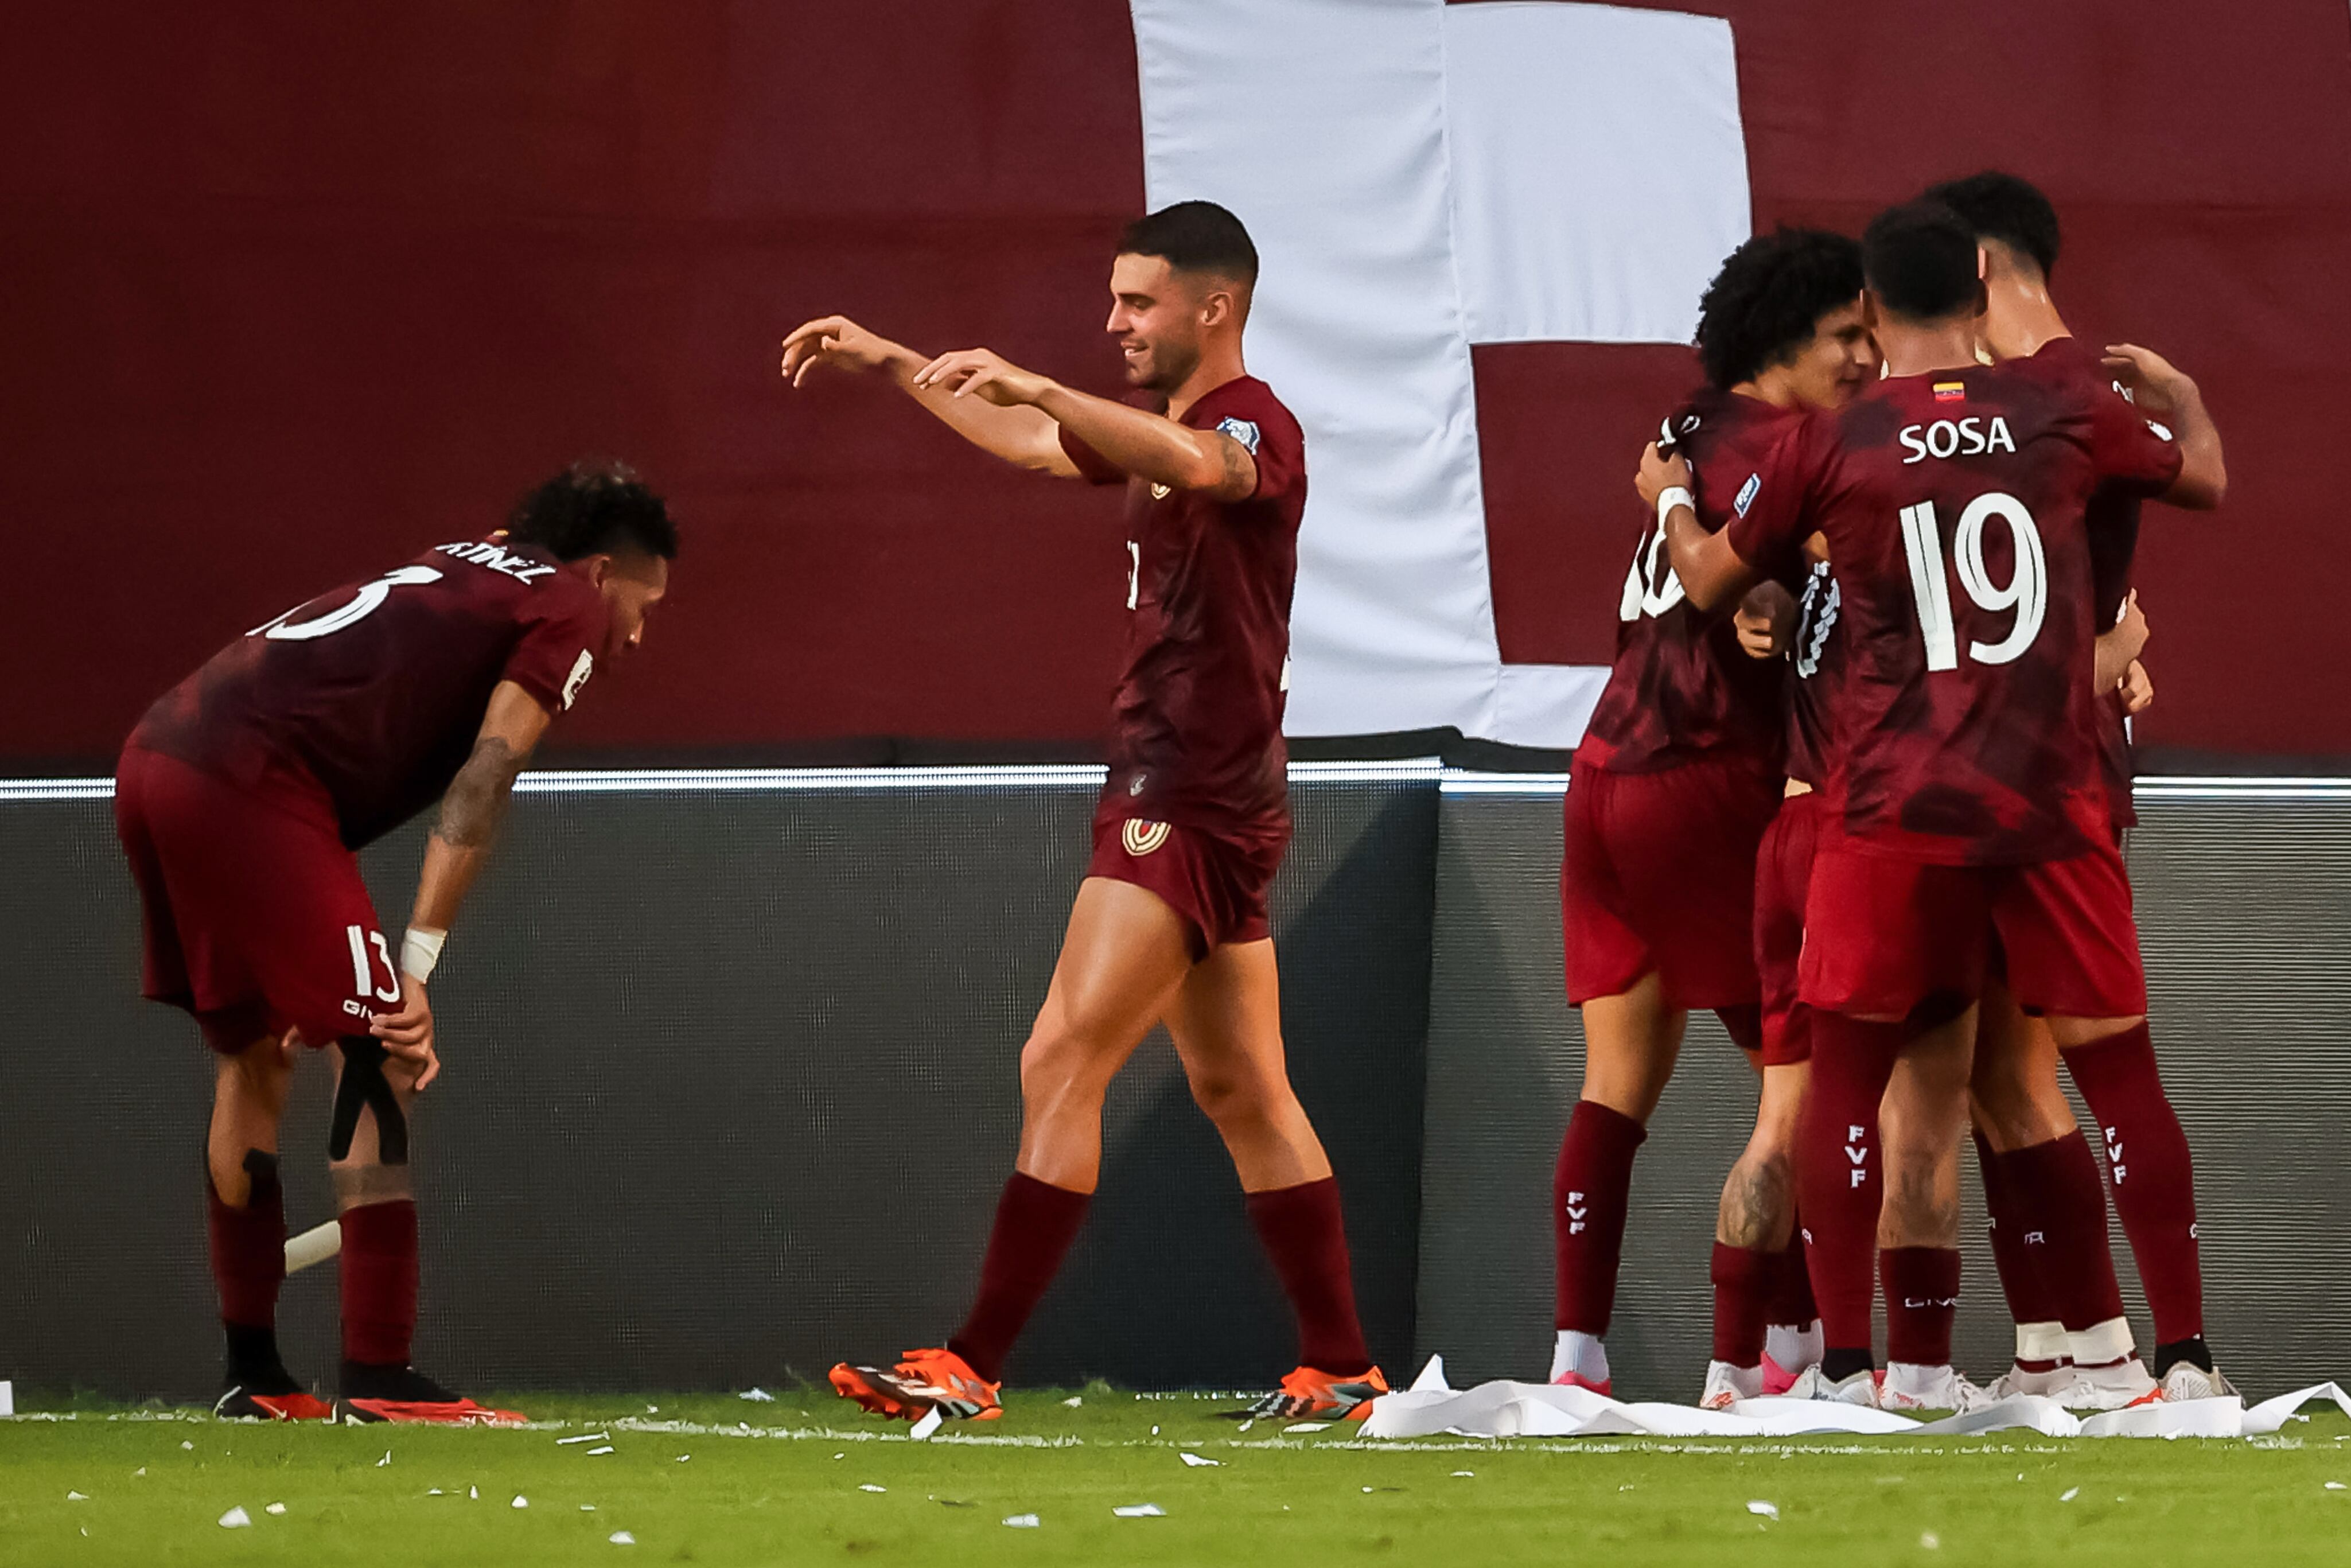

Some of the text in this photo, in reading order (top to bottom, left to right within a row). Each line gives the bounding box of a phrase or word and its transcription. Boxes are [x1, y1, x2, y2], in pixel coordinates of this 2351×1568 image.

[1899, 417, 2017, 464] SOSA
[1899, 492, 2048, 672] 19
[346, 924, 400, 1003] 13
[1844, 1125, 1868, 1188] FVF
[2105, 1126, 2127, 1185] FVF
[1566, 1191, 1587, 1235] FVF
